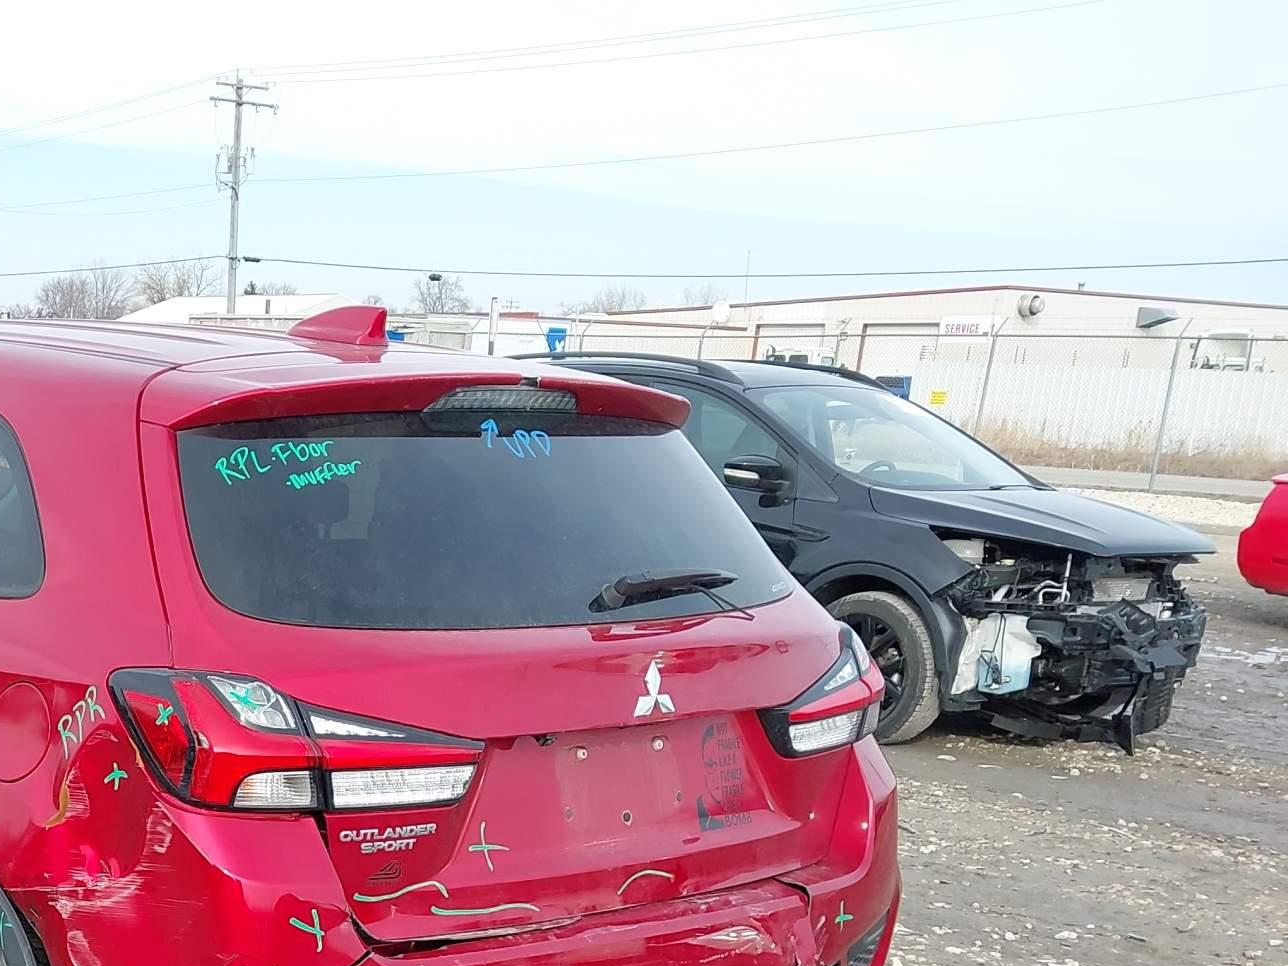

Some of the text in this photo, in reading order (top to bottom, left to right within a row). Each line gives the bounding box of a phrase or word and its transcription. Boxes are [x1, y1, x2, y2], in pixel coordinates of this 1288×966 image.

[944, 323, 980, 334] SERVICE
[339, 823, 437, 842] OUTLANDER
[360, 838, 417, 854] SPORT
